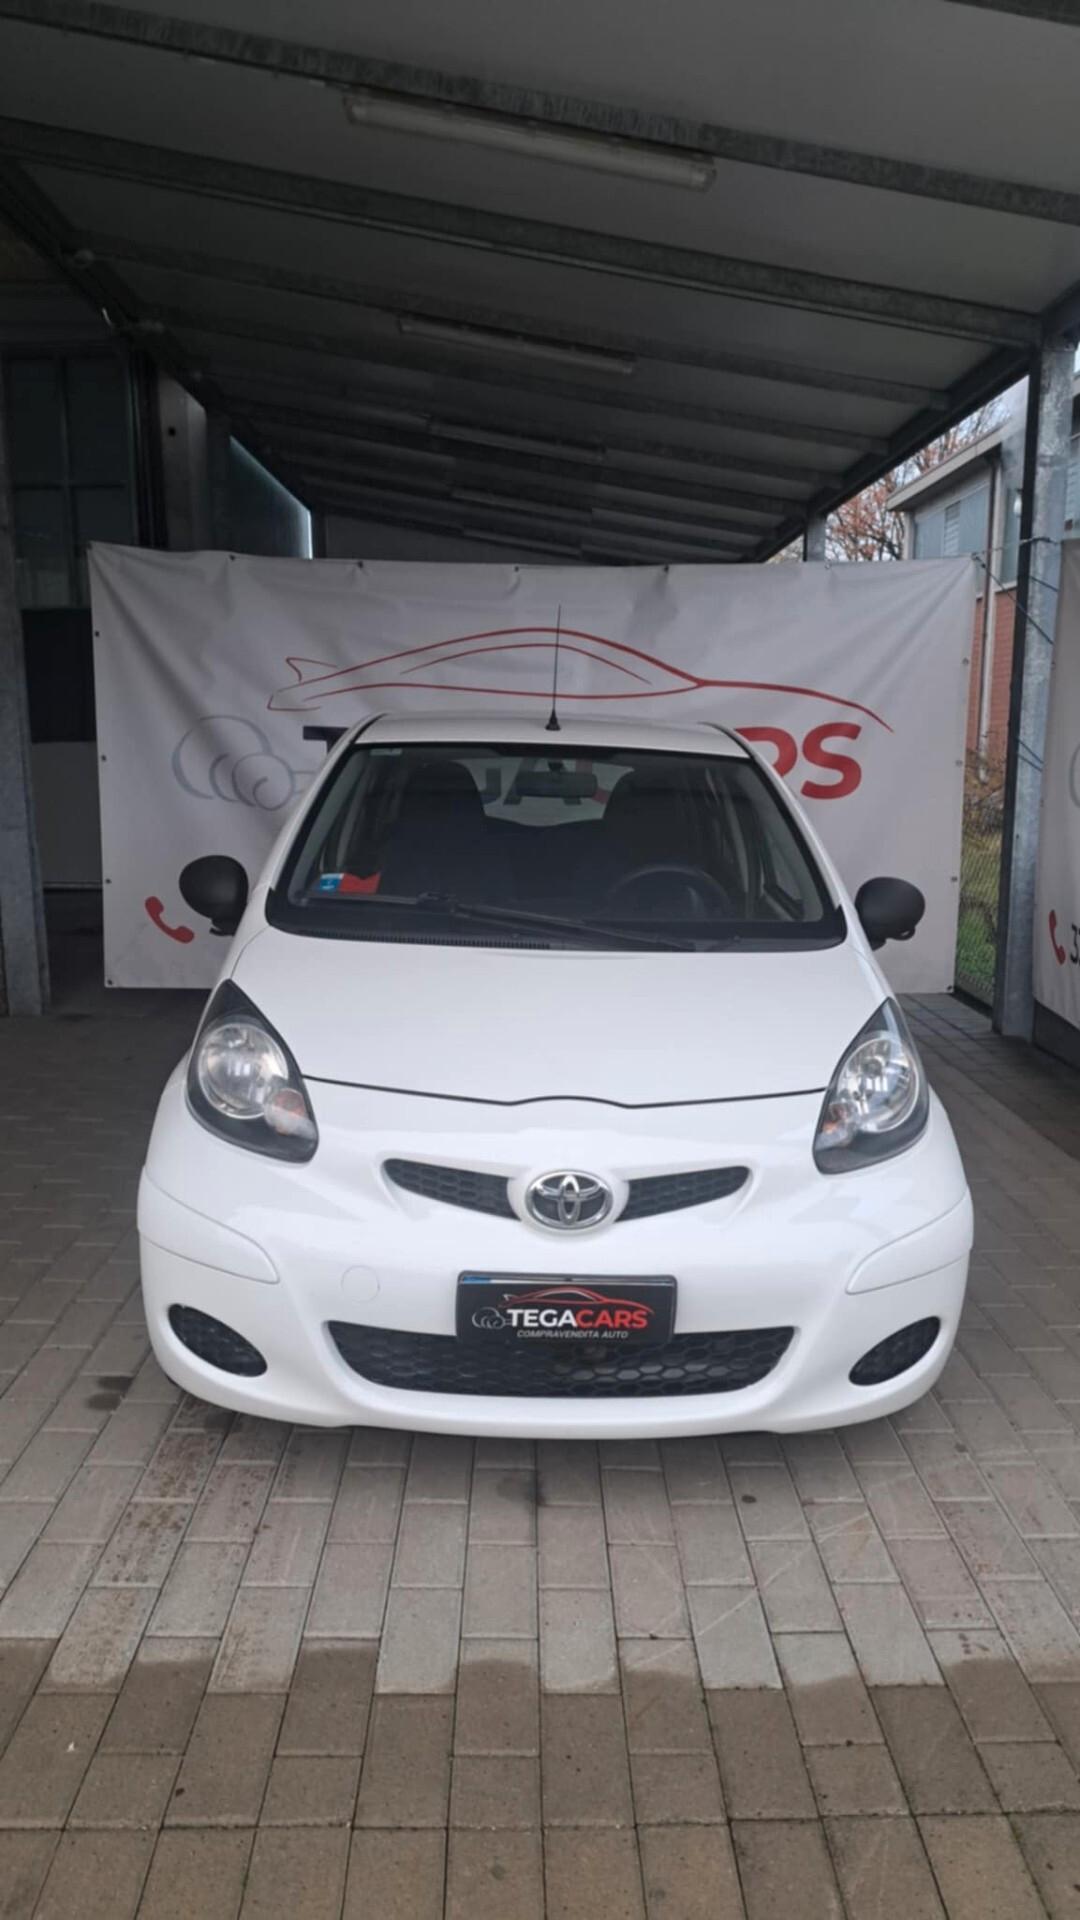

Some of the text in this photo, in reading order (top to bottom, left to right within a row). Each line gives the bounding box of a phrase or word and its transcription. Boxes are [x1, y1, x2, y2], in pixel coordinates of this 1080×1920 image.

[507, 1308, 648, 1328] TEGACARS
[517, 1329, 629, 1339] COMPRAVENDITA AUTO
